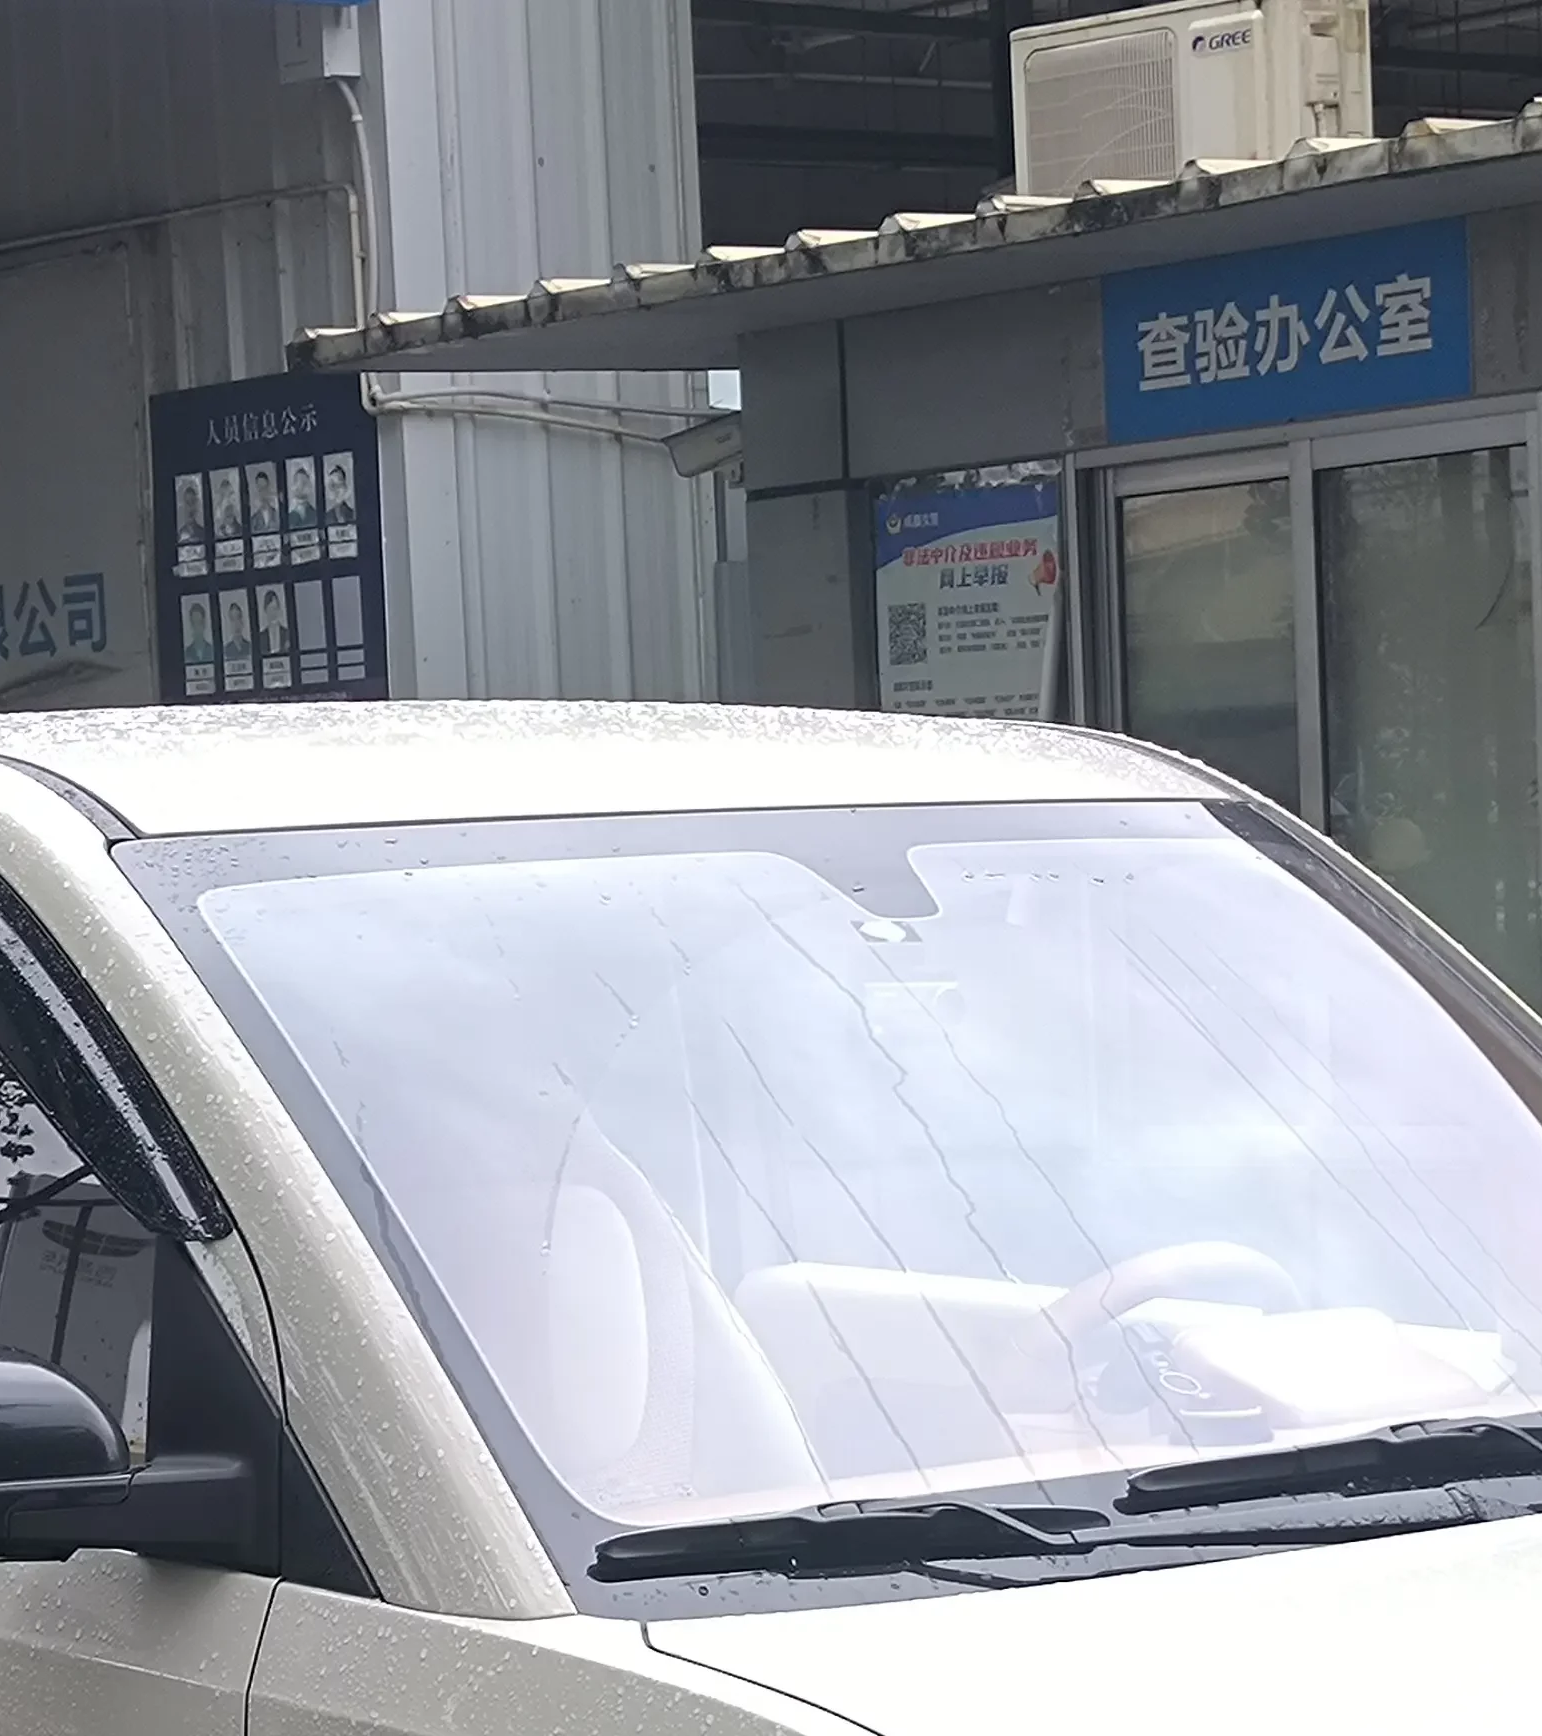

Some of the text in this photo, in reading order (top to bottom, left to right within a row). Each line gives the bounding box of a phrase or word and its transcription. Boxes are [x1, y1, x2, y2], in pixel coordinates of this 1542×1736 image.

[1208, 29, 1252, 51] GREE
[1135, 273, 1433, 393] 查验办公室
[205, 402, 320, 447] 人员信息公示
